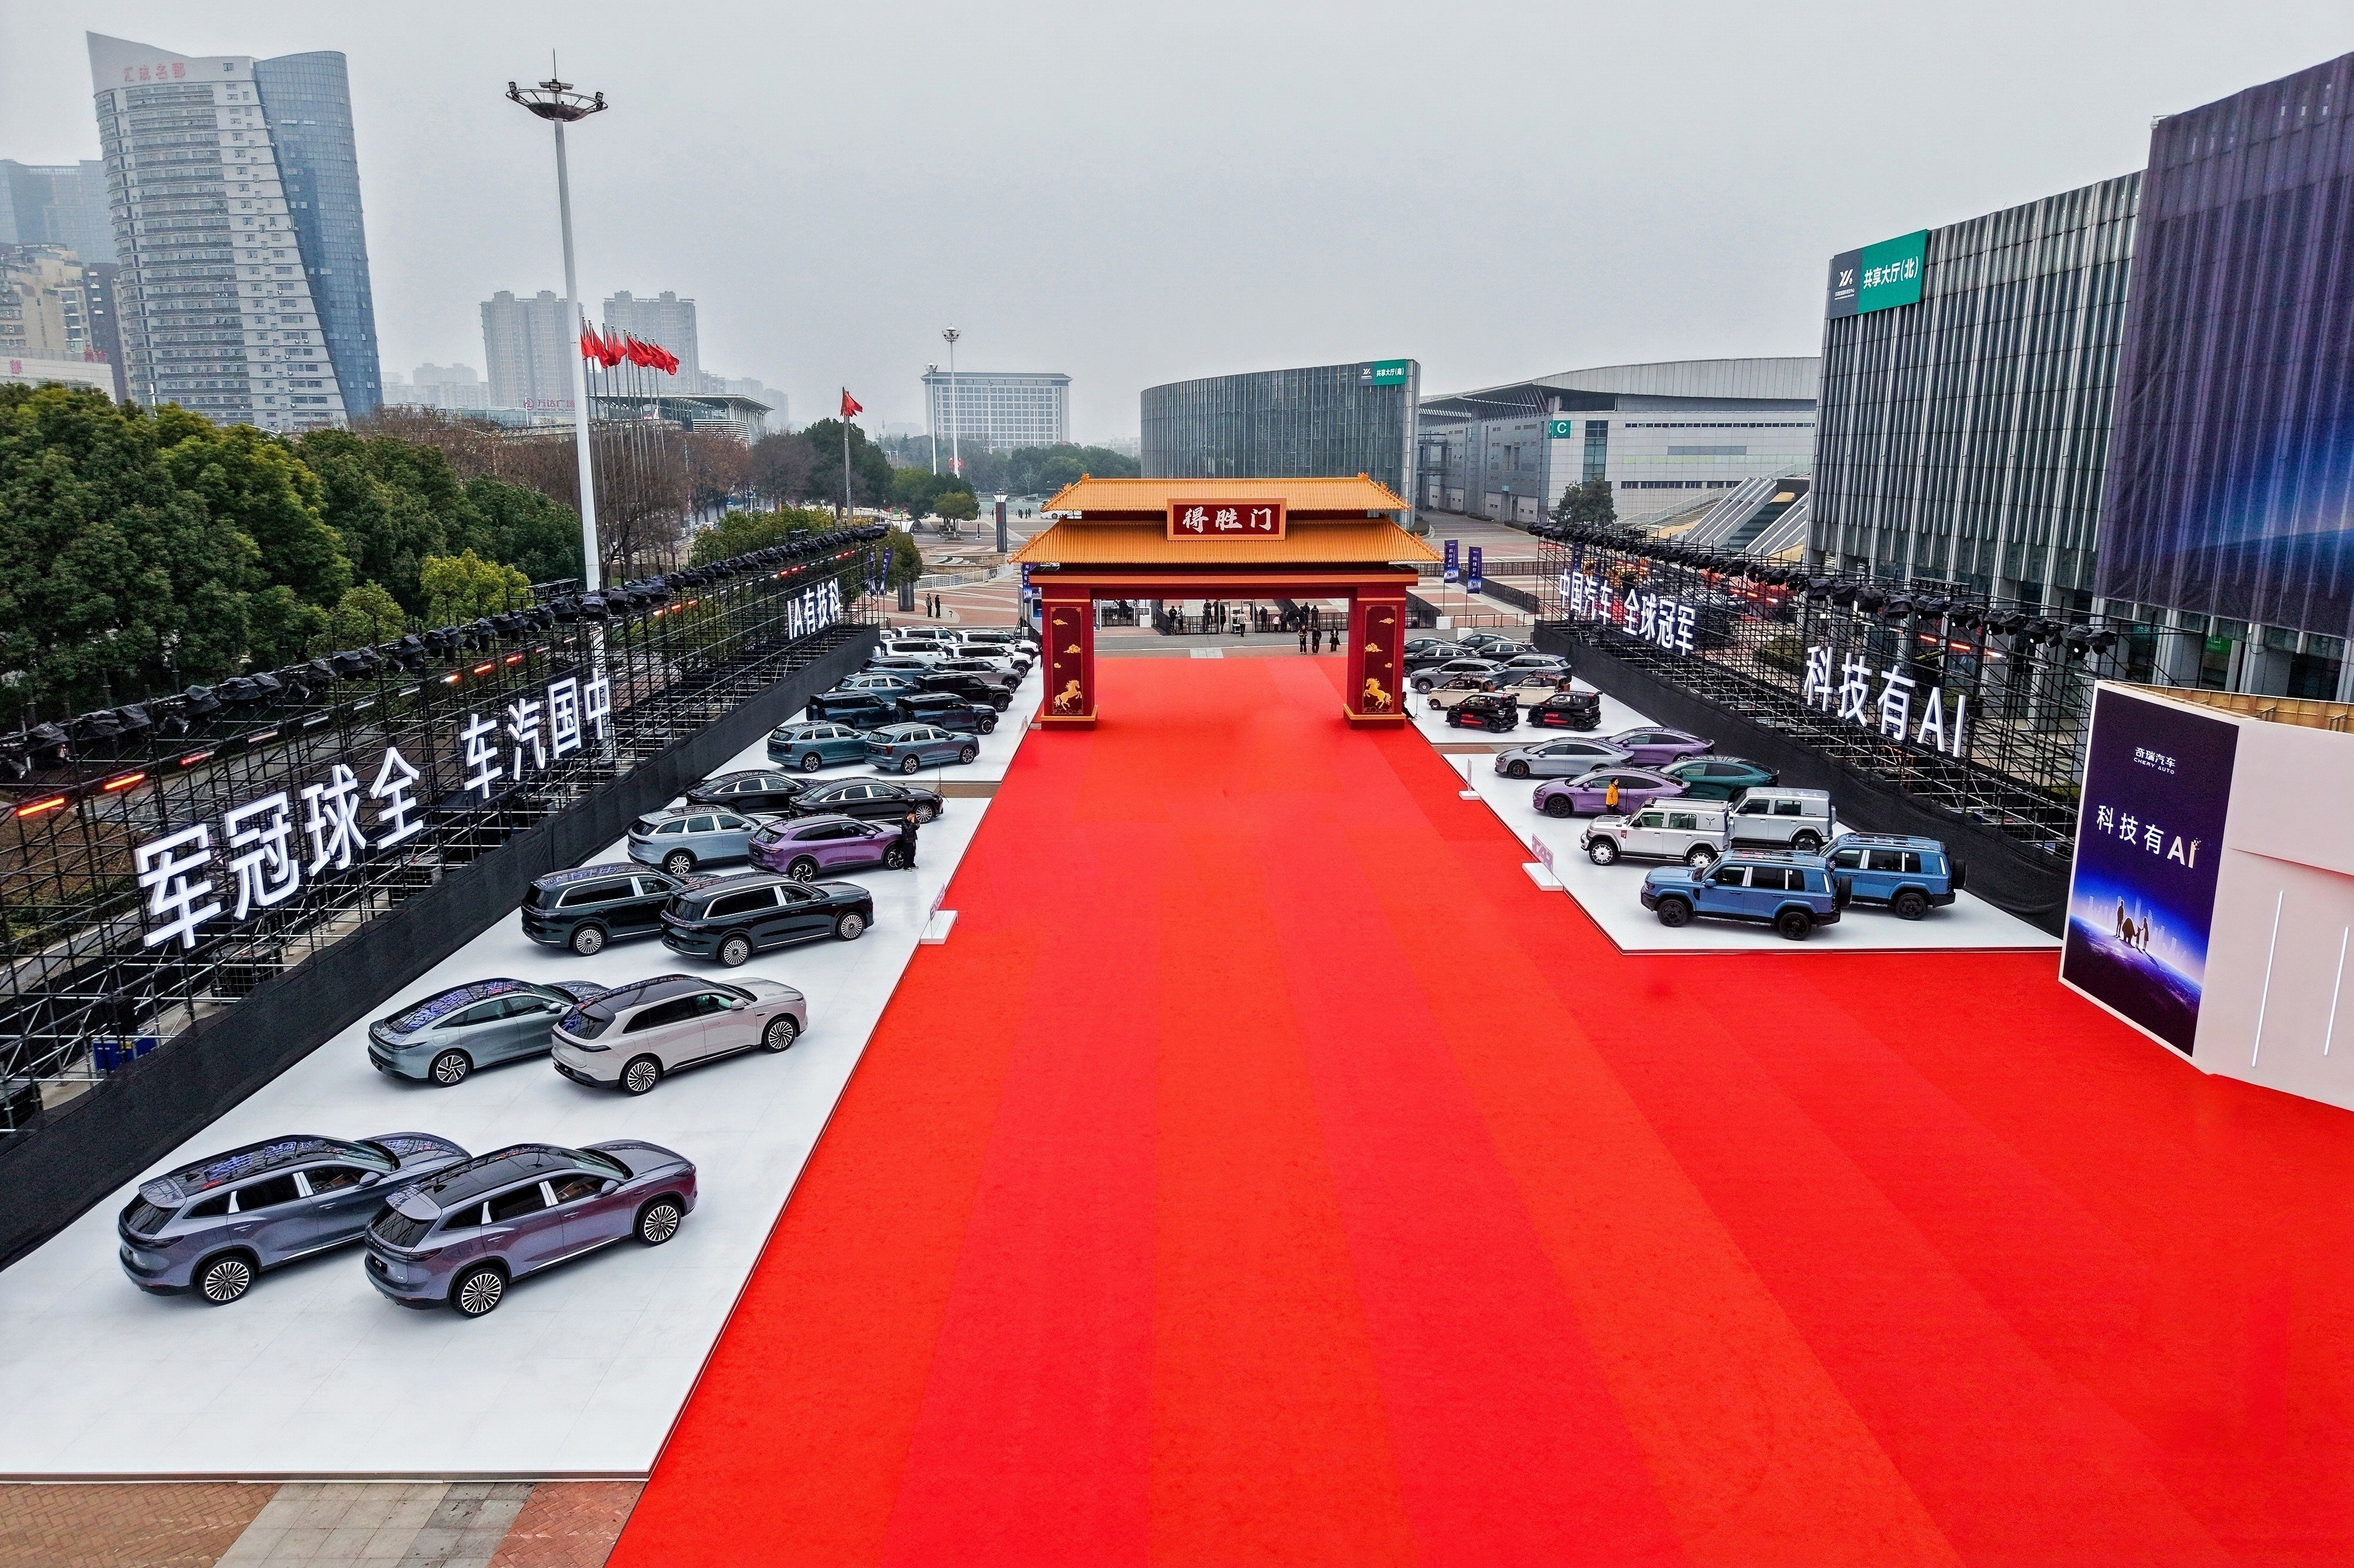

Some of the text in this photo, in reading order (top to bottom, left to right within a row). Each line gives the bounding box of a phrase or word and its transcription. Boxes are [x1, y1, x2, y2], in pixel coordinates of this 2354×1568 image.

[1863, 256, 1919, 289] 共享大厅(北)
[1376, 367, 1404, 377] 共享大厅(南)
[1557, 422, 1567, 433] C
[1183, 506, 1272, 533] 得胜门
[1560, 568, 1695, 655] 中国汽车 全球冠军
[1803, 646, 1966, 757] 科技有AI
[2134, 758, 2174, 774] CHERY AUTO
[2135, 747, 2176, 767] 奇瑞汽车
[2097, 805, 2197, 868] 科技有AI
